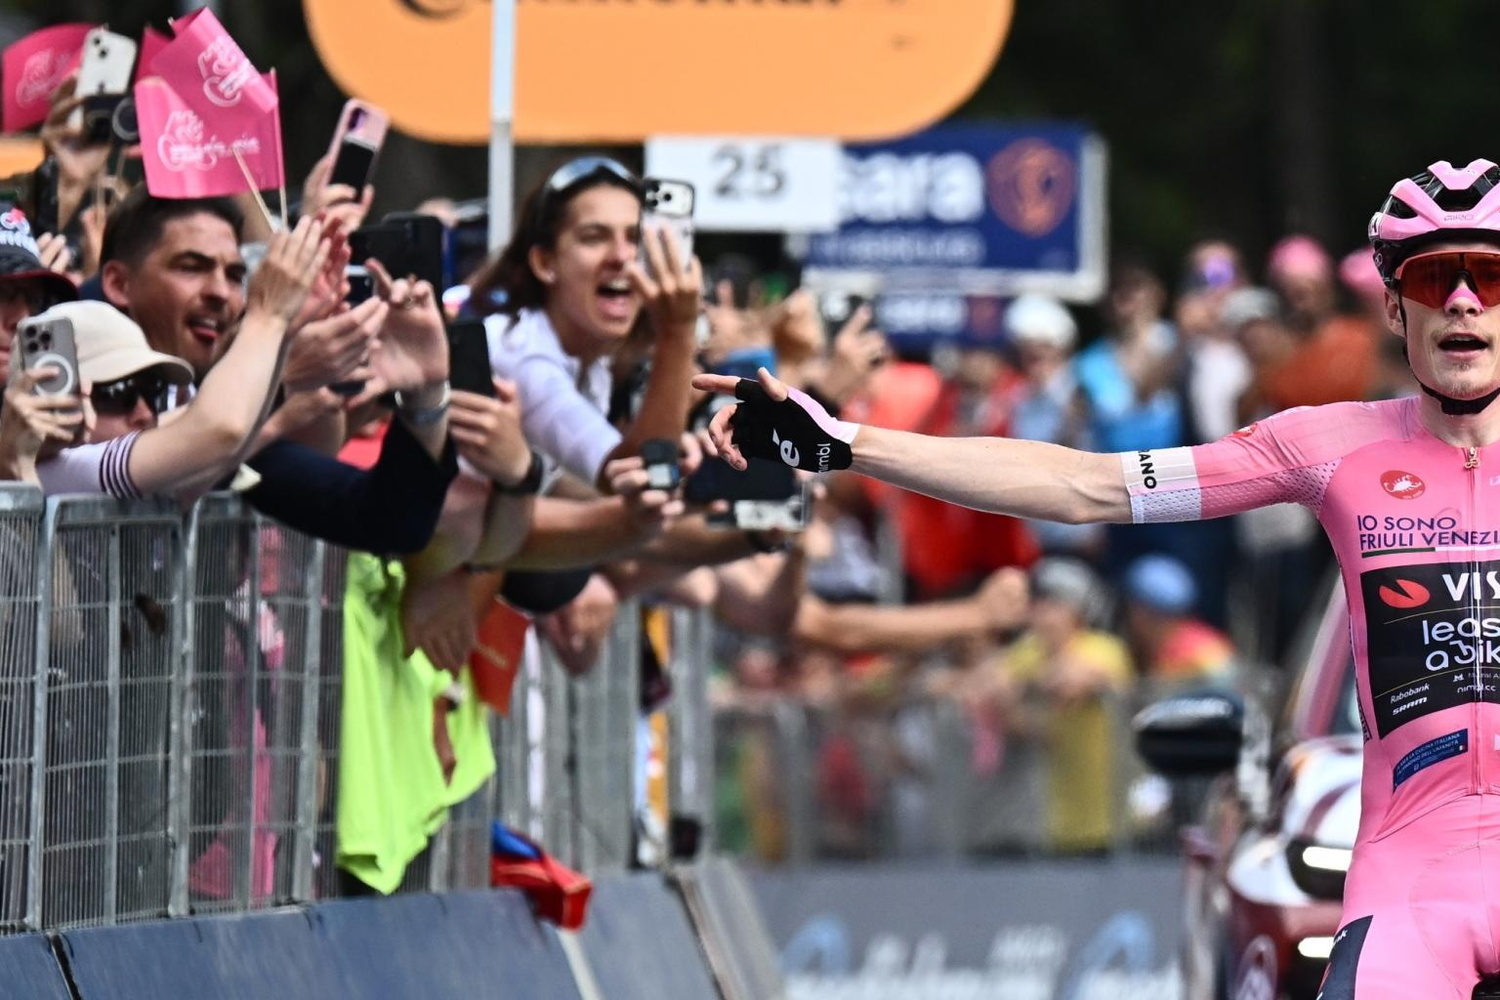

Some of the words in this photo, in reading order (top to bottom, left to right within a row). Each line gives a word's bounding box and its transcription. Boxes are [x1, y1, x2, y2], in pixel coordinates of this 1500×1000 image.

[713, 143, 785, 198] 25
[1357, 515, 1378, 531] IO
[1384, 516, 1456, 531] SONO
[1360, 532, 1413, 550] FRIULI
[1391, 682, 1430, 703] Rabobank
